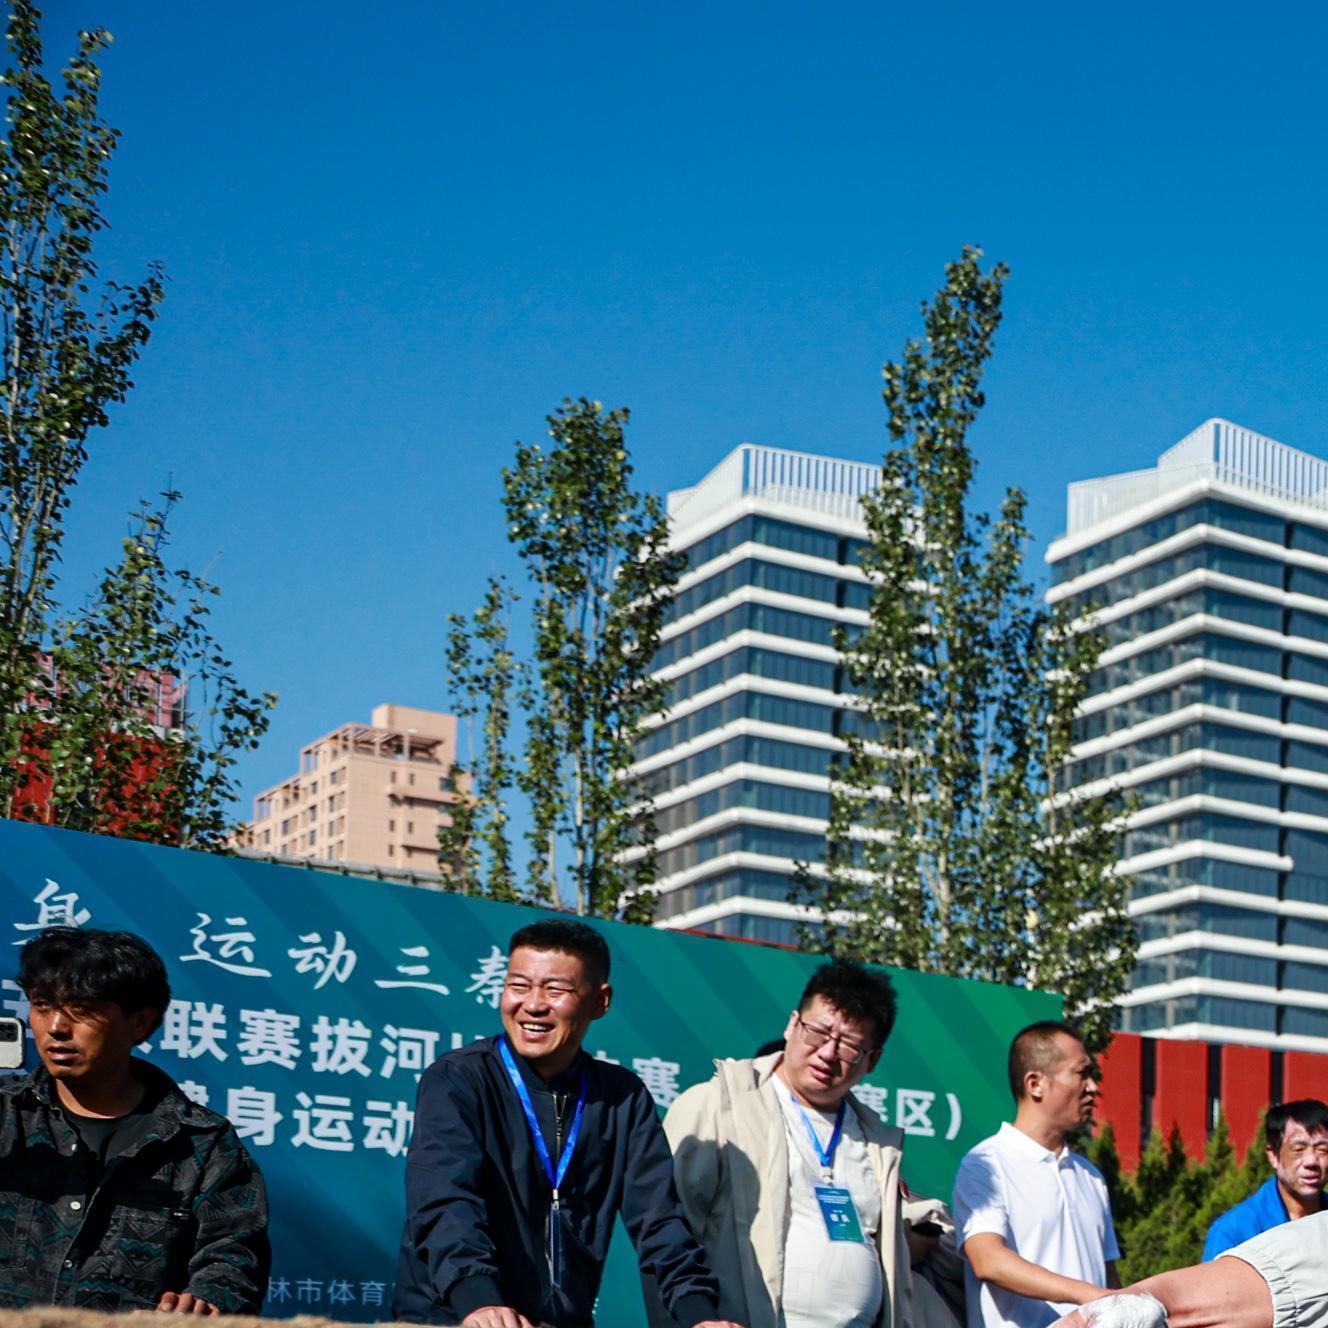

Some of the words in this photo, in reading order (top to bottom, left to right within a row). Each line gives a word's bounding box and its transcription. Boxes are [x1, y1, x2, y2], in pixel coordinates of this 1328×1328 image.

[160, 999, 486, 1084] 联赛拔河
[178, 1080, 415, 1158] 身运动
[266, 1276, 396, 1307] 林市体育
